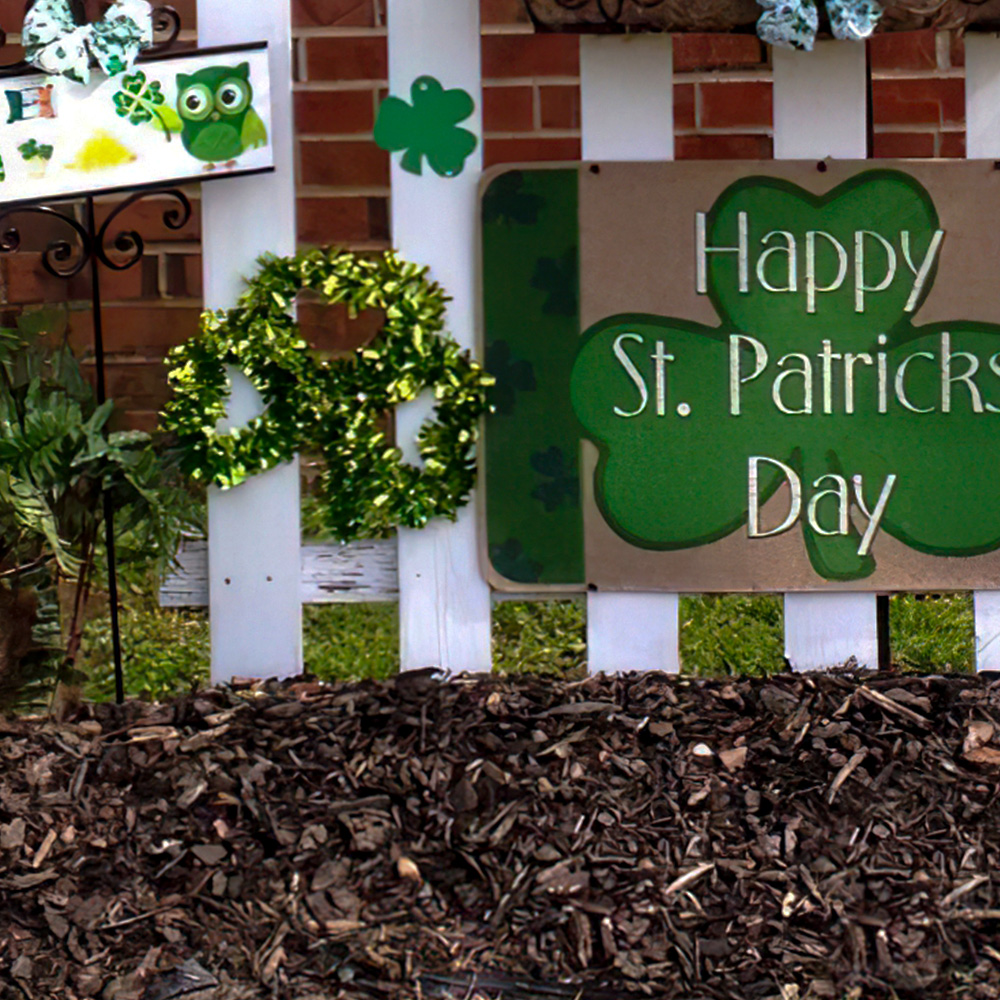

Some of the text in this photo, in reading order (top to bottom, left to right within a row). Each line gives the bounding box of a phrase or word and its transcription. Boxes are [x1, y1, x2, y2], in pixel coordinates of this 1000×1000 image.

[695, 210, 945, 313] Happy
[612, 332, 692, 417] St.
[746, 455, 897, 556] Day
